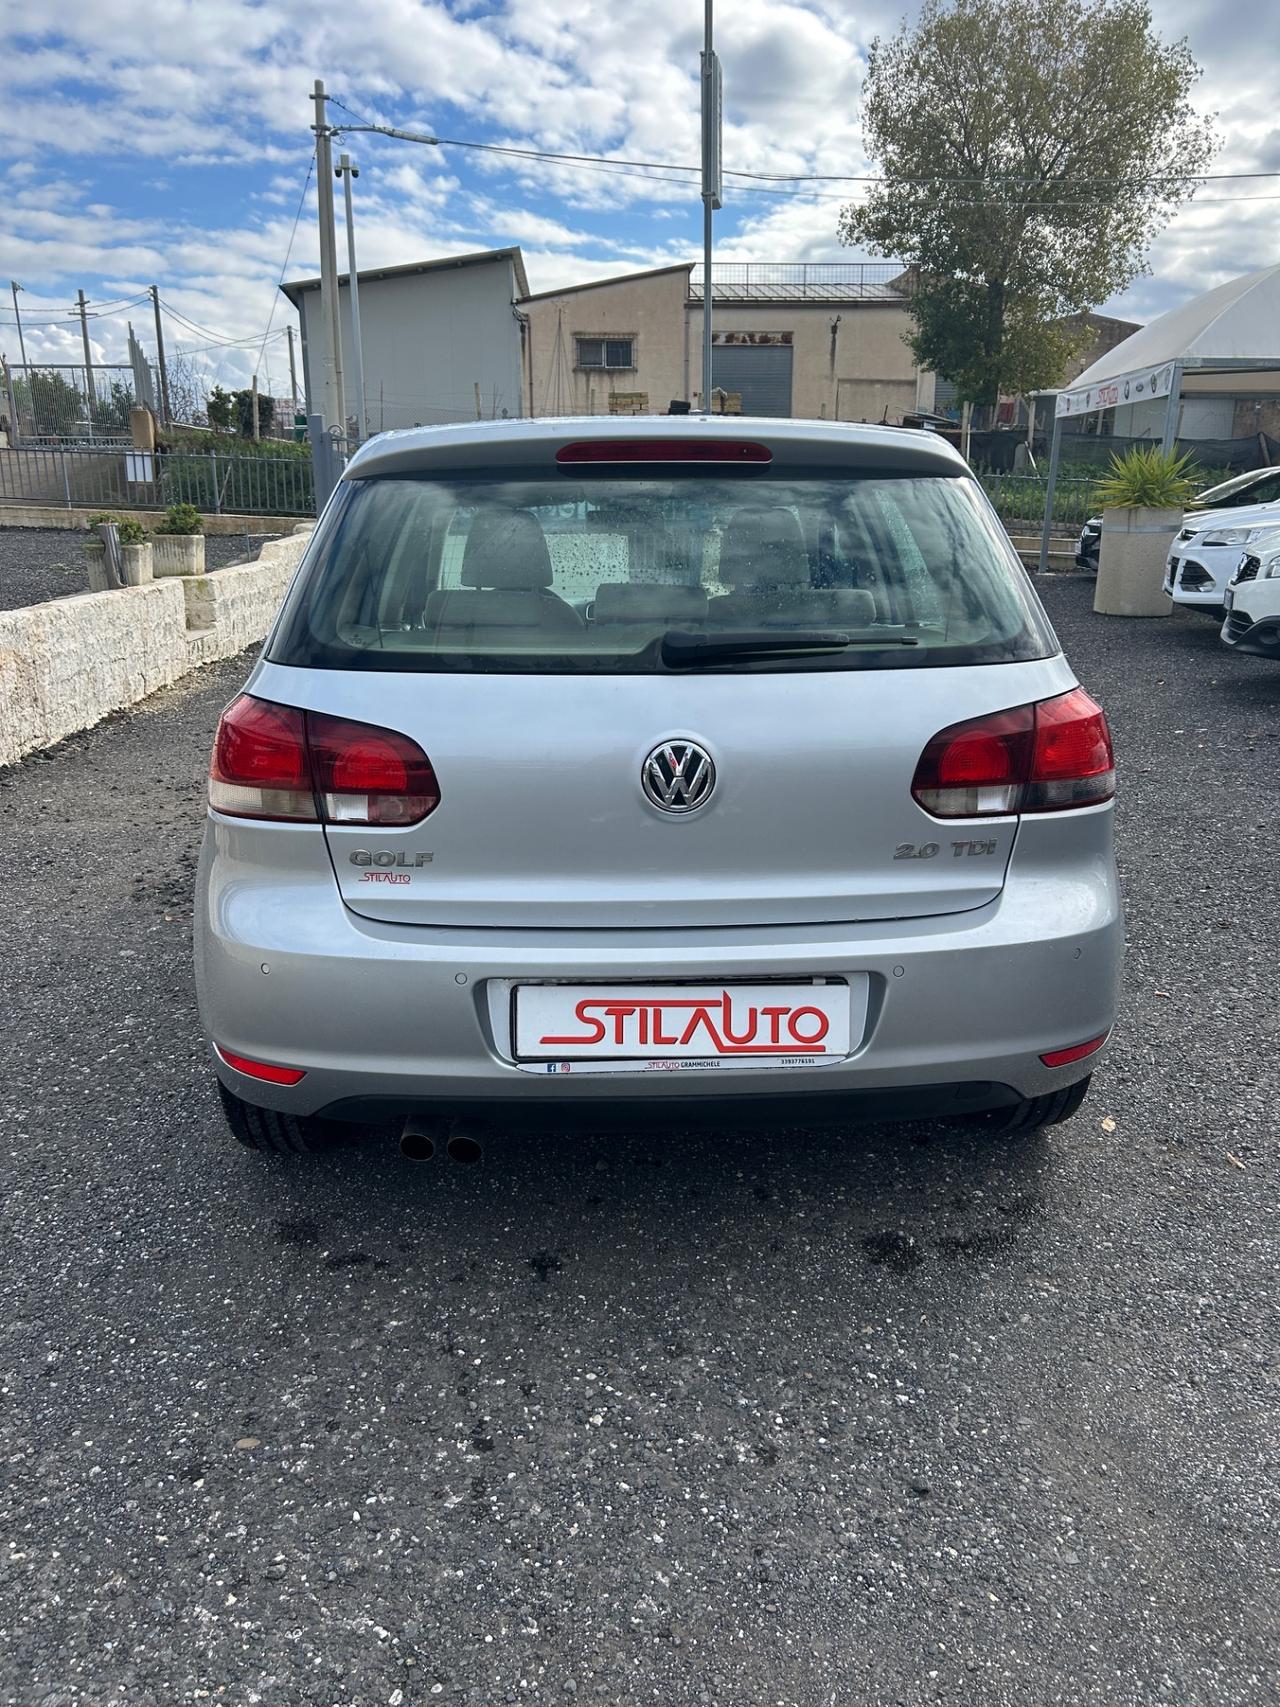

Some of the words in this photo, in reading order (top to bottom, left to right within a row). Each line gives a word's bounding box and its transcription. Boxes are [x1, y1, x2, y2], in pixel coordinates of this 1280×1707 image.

[349, 849, 434, 868] GOLF
[893, 841, 940, 860] 2.0
[358, 871, 411, 885] STILAUTO
[540, 990, 830, 1054] STILAUTO
[645, 1061, 680, 1070] STILAUTO
[680, 1060, 721, 1068] GRAMMICHELE
